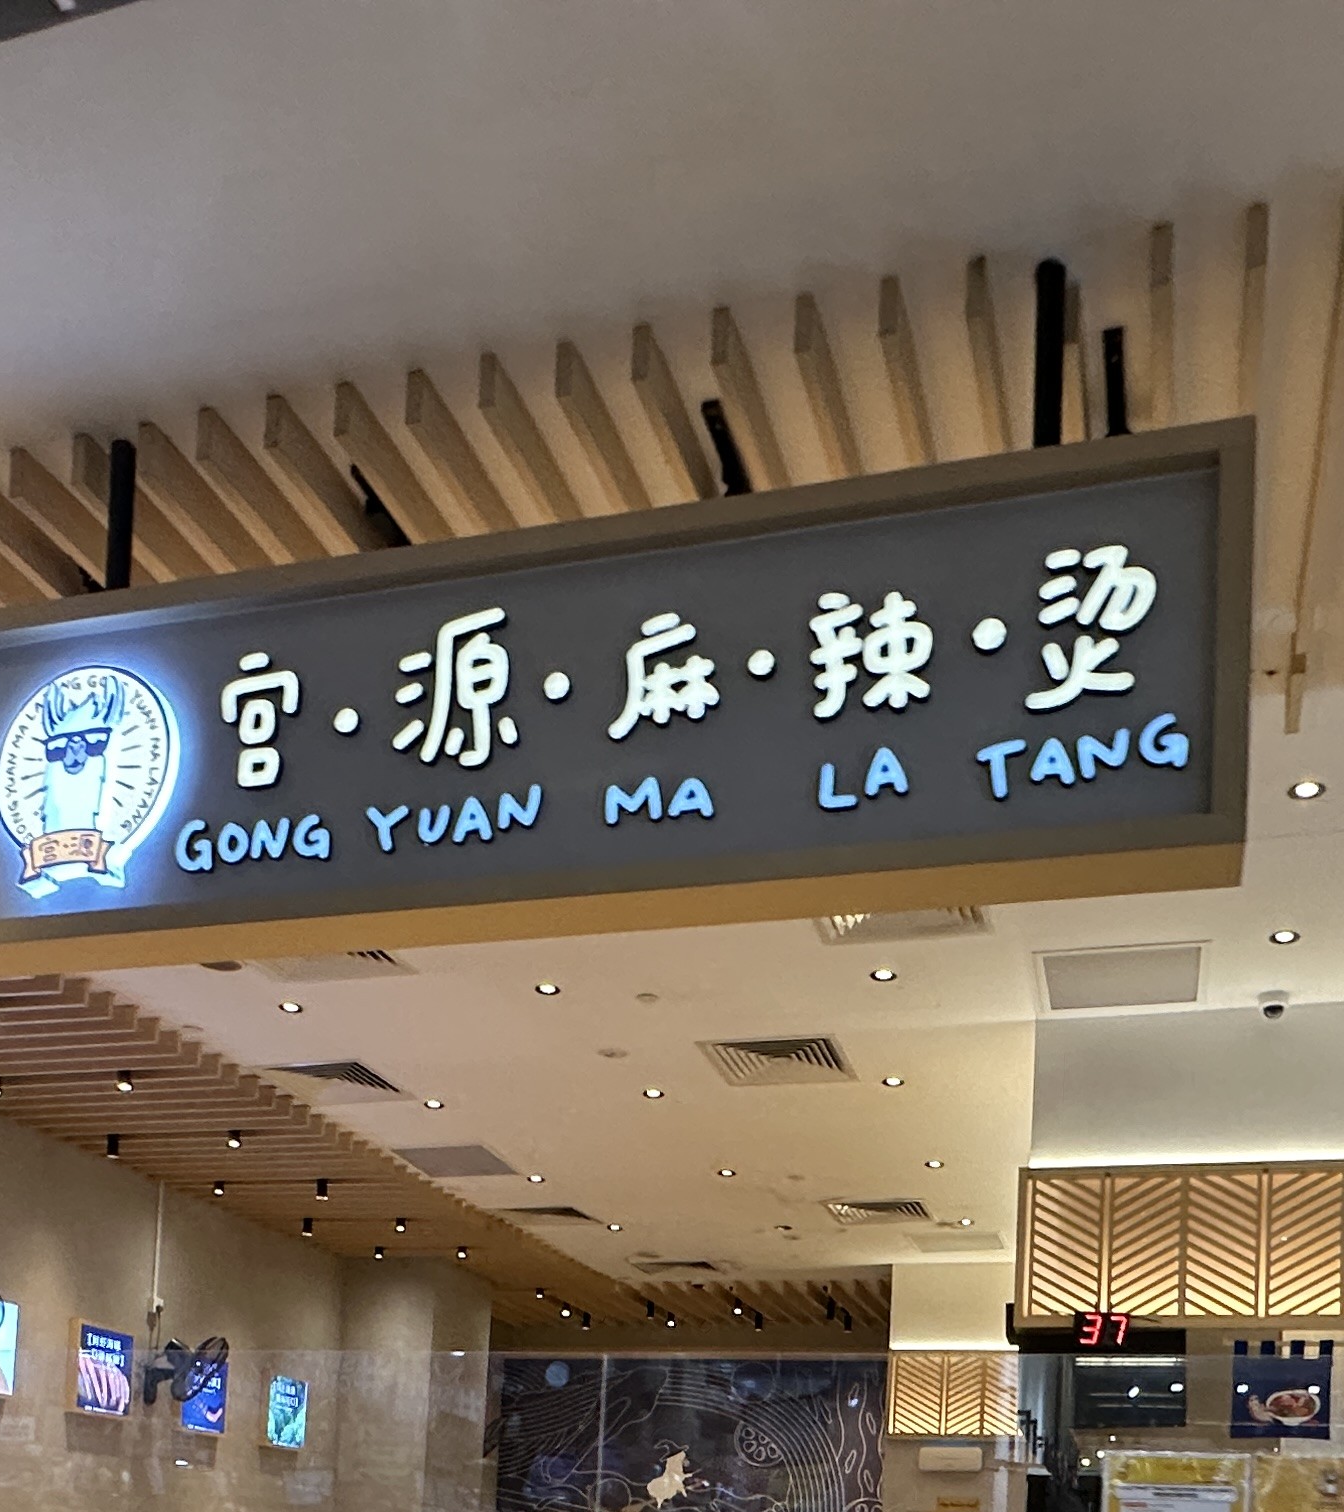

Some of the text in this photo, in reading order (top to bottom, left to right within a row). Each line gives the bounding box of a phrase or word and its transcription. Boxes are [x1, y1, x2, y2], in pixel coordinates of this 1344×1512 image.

[174, 712, 1190, 873] GONG YUAN MA LA TANG
[1079, 1314, 1128, 1346] 37
